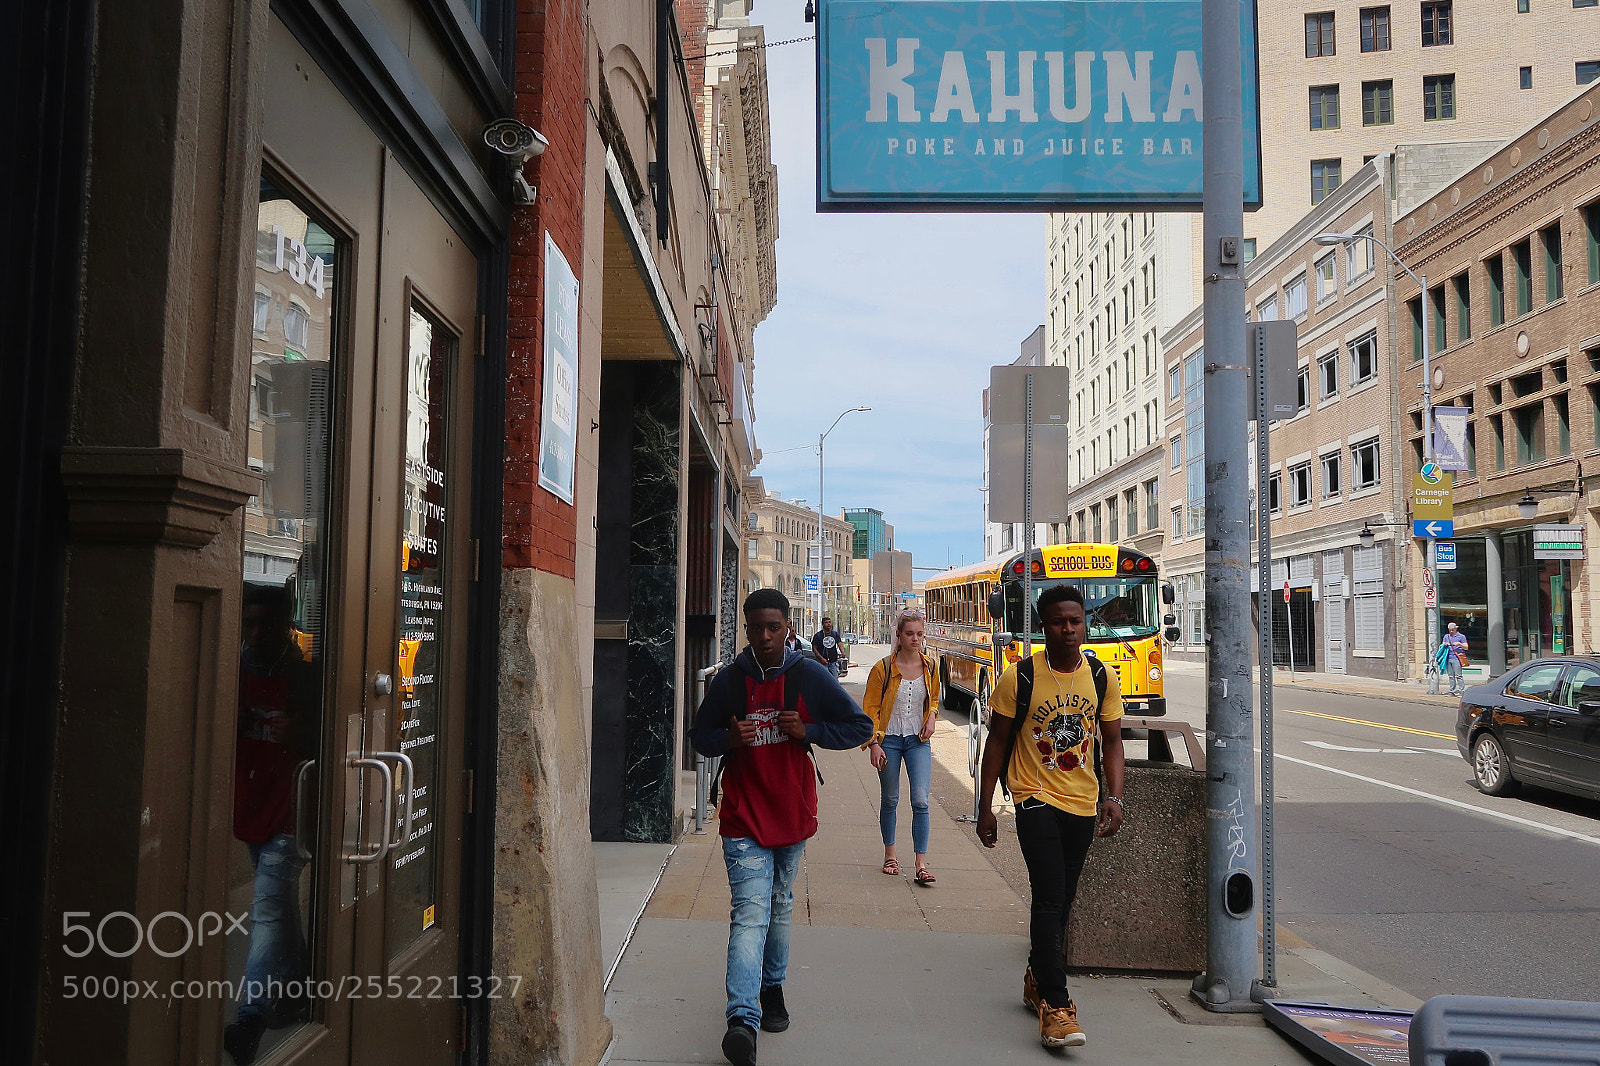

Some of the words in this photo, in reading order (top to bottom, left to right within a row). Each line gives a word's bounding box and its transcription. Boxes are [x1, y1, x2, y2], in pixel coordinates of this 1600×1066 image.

[864, 37, 1204, 123] KAHUNA
[887, 138, 955, 155] POKE
[974, 138, 1025, 155] AND
[1044, 138, 1124, 155] JUICE
[1143, 137, 1193, 155] BAR
[272, 225, 325, 300] 134
[1415, 488, 1450, 498] Carnegie
[1415, 497, 1443, 507] Library
[407, 530, 437, 556] SUITES
[1050, 556, 1090, 571] SCHOOL
[1091, 555, 1113, 570] BUS
[1437, 552, 1454, 561] Stop
[1504, 580, 1517, 591] 135
[1032, 693, 1095, 725] HOLLISTER
